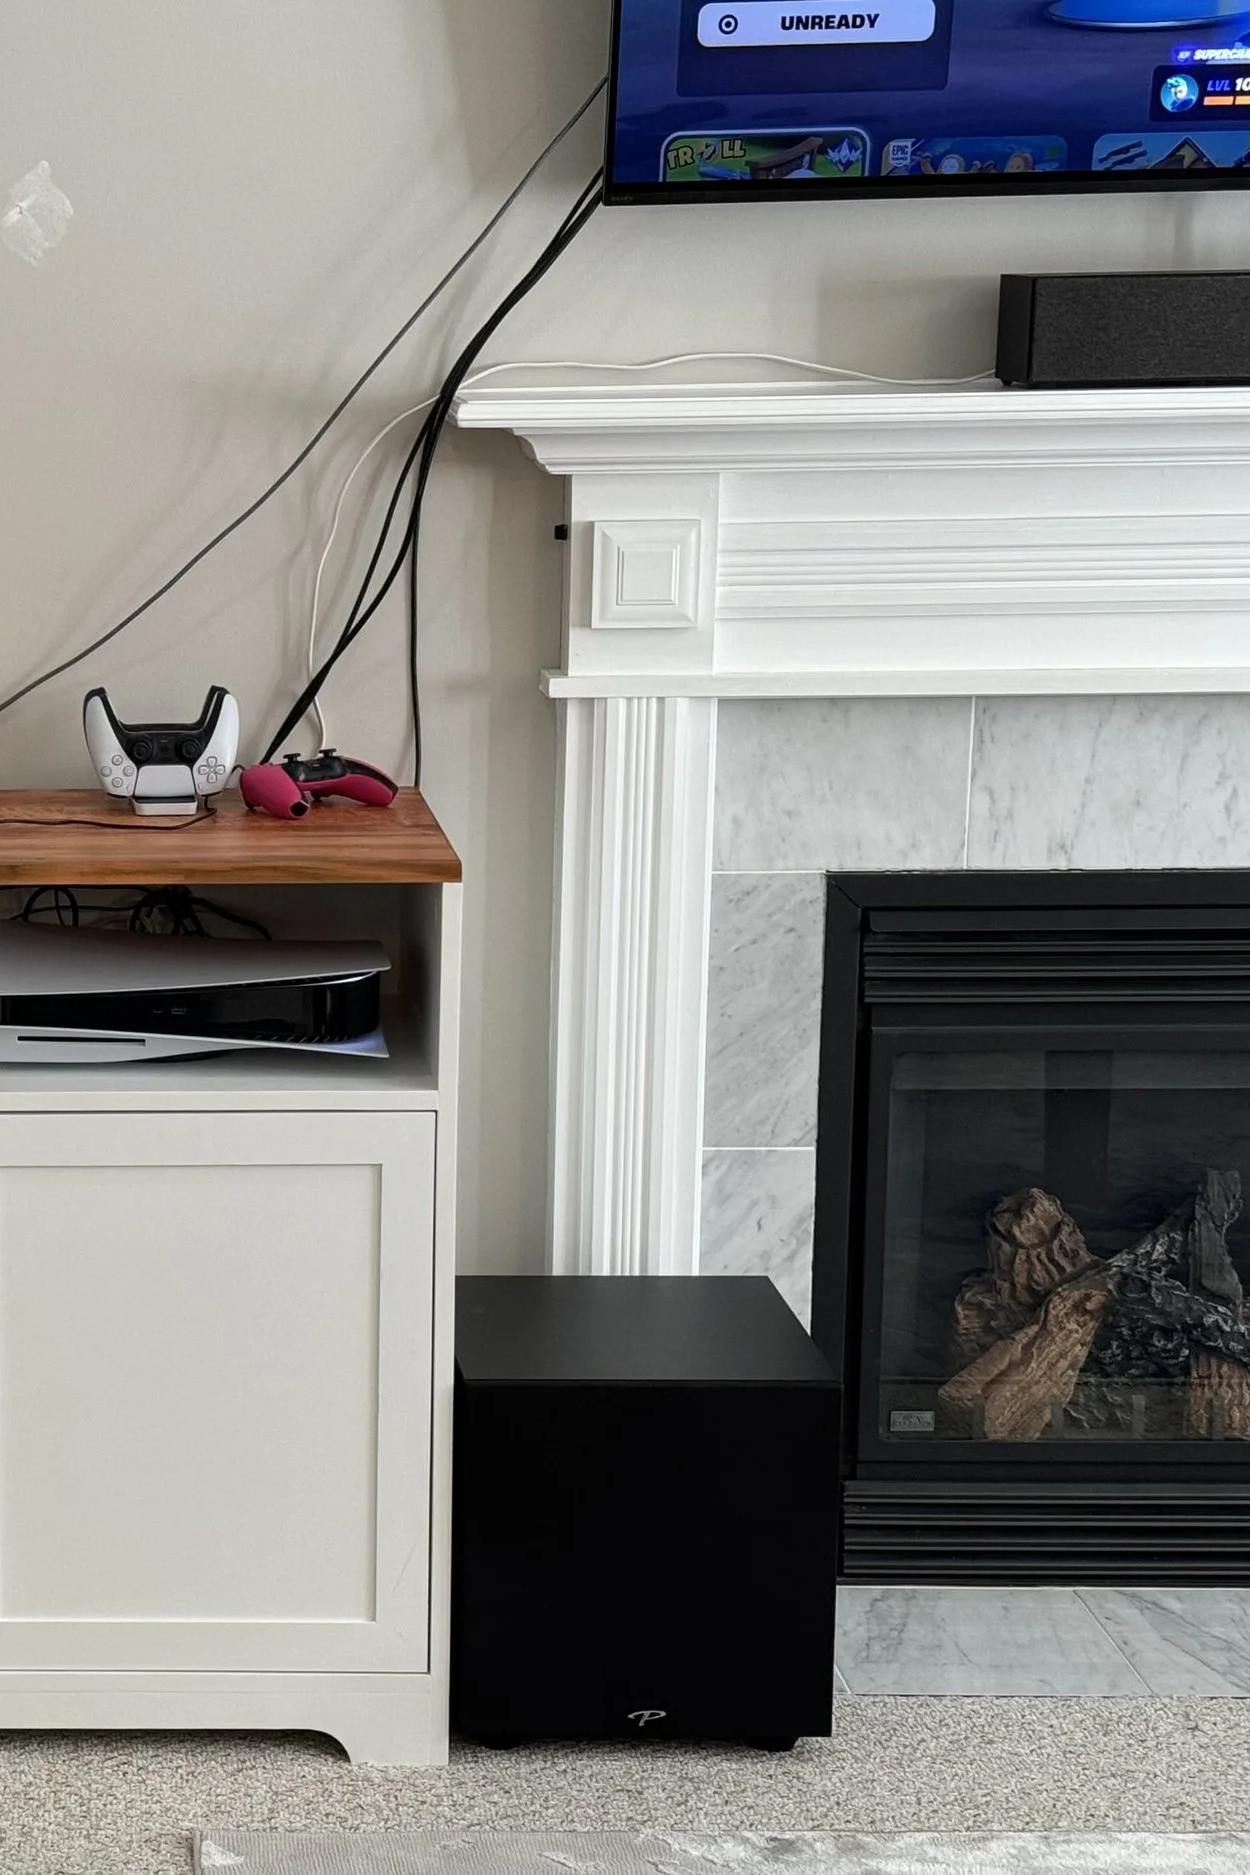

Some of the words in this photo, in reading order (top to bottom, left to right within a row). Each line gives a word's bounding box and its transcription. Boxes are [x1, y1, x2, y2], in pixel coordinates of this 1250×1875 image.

[780, 13, 880, 31] UNREADY
[1206, 79, 1231, 92] LVL
[892, 145, 909, 156] EPIC
